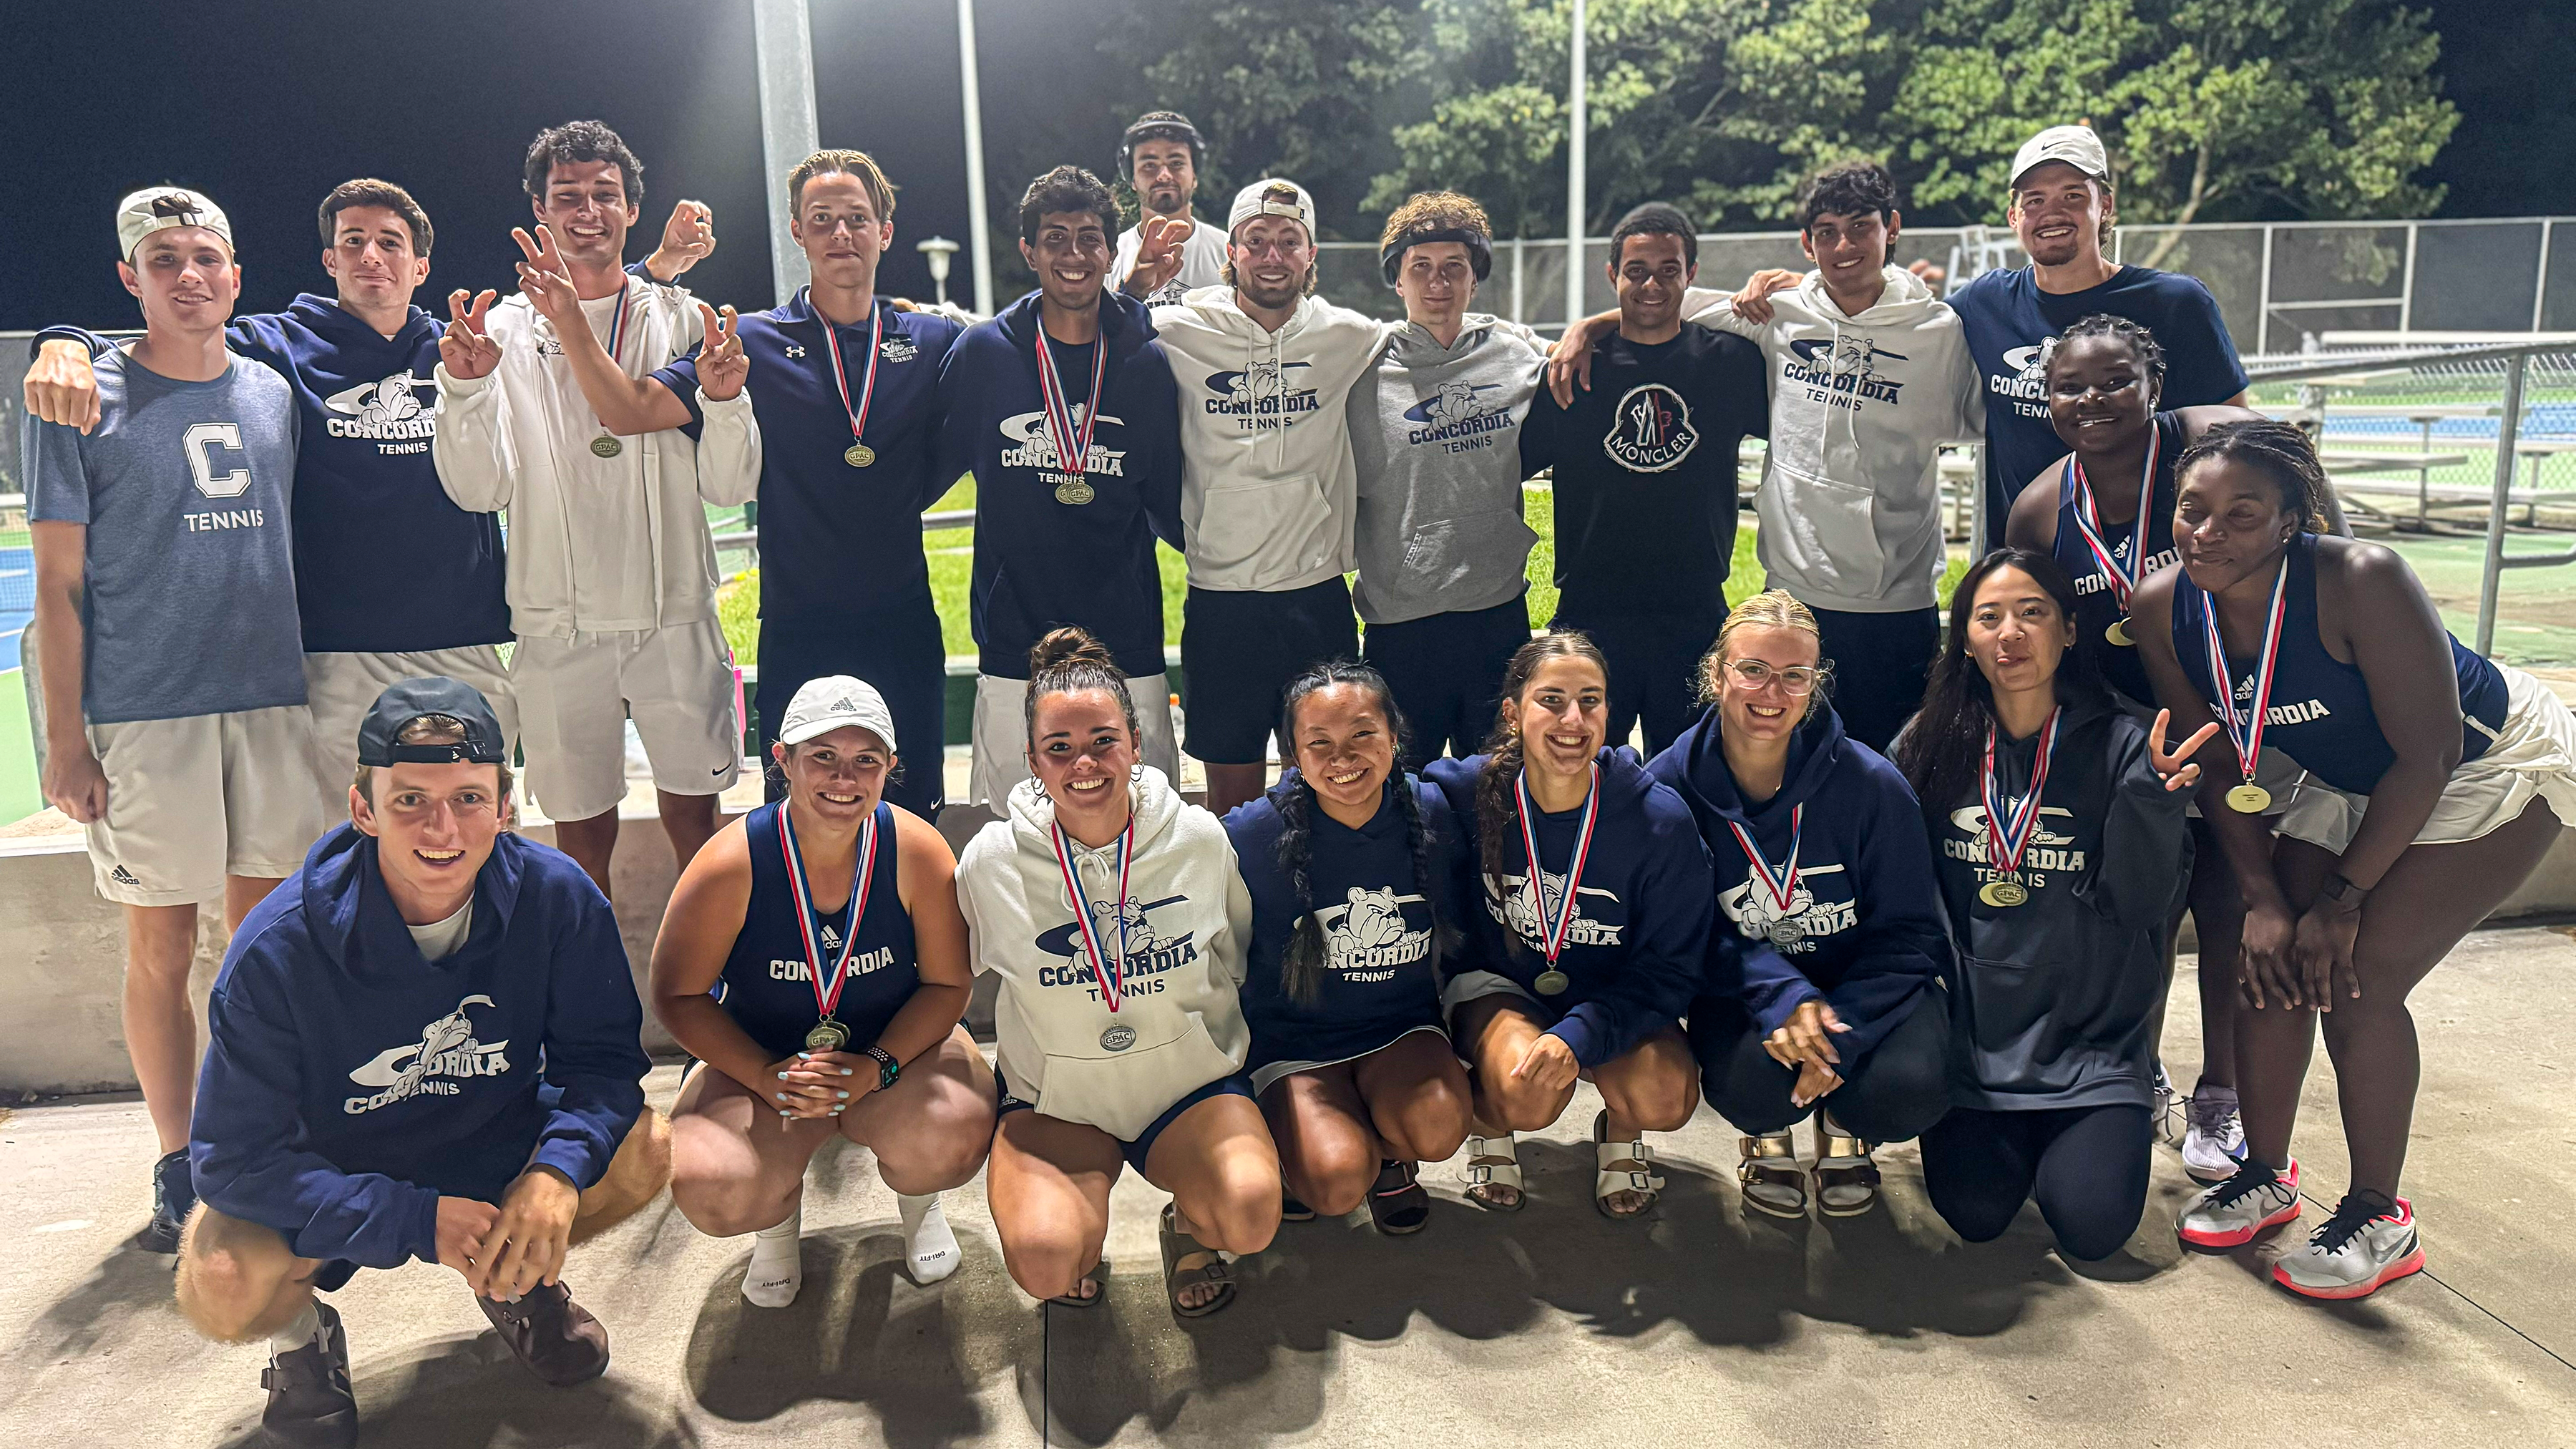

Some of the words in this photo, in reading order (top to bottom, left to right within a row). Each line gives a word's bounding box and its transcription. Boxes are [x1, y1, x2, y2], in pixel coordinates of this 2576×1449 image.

[889, 354, 913, 364] TENNIS
[1784, 363, 1898, 405] CONCORDIA
[1205, 396, 1320, 414] CONCORDIA
[2013, 401, 2052, 419] TENN
[1409, 414, 1516, 445] CONCORDIA
[377, 441, 429, 455] TENNIS
[1442, 435, 1493, 454] TENNIS
[1611, 432, 1692, 464] MONCLER
[182, 423, 250, 498] C
[183, 509, 264, 532] TENNIS
[1342, 969, 1396, 982] TENNIS
[1105, 1033, 1131, 1045] GPAC
